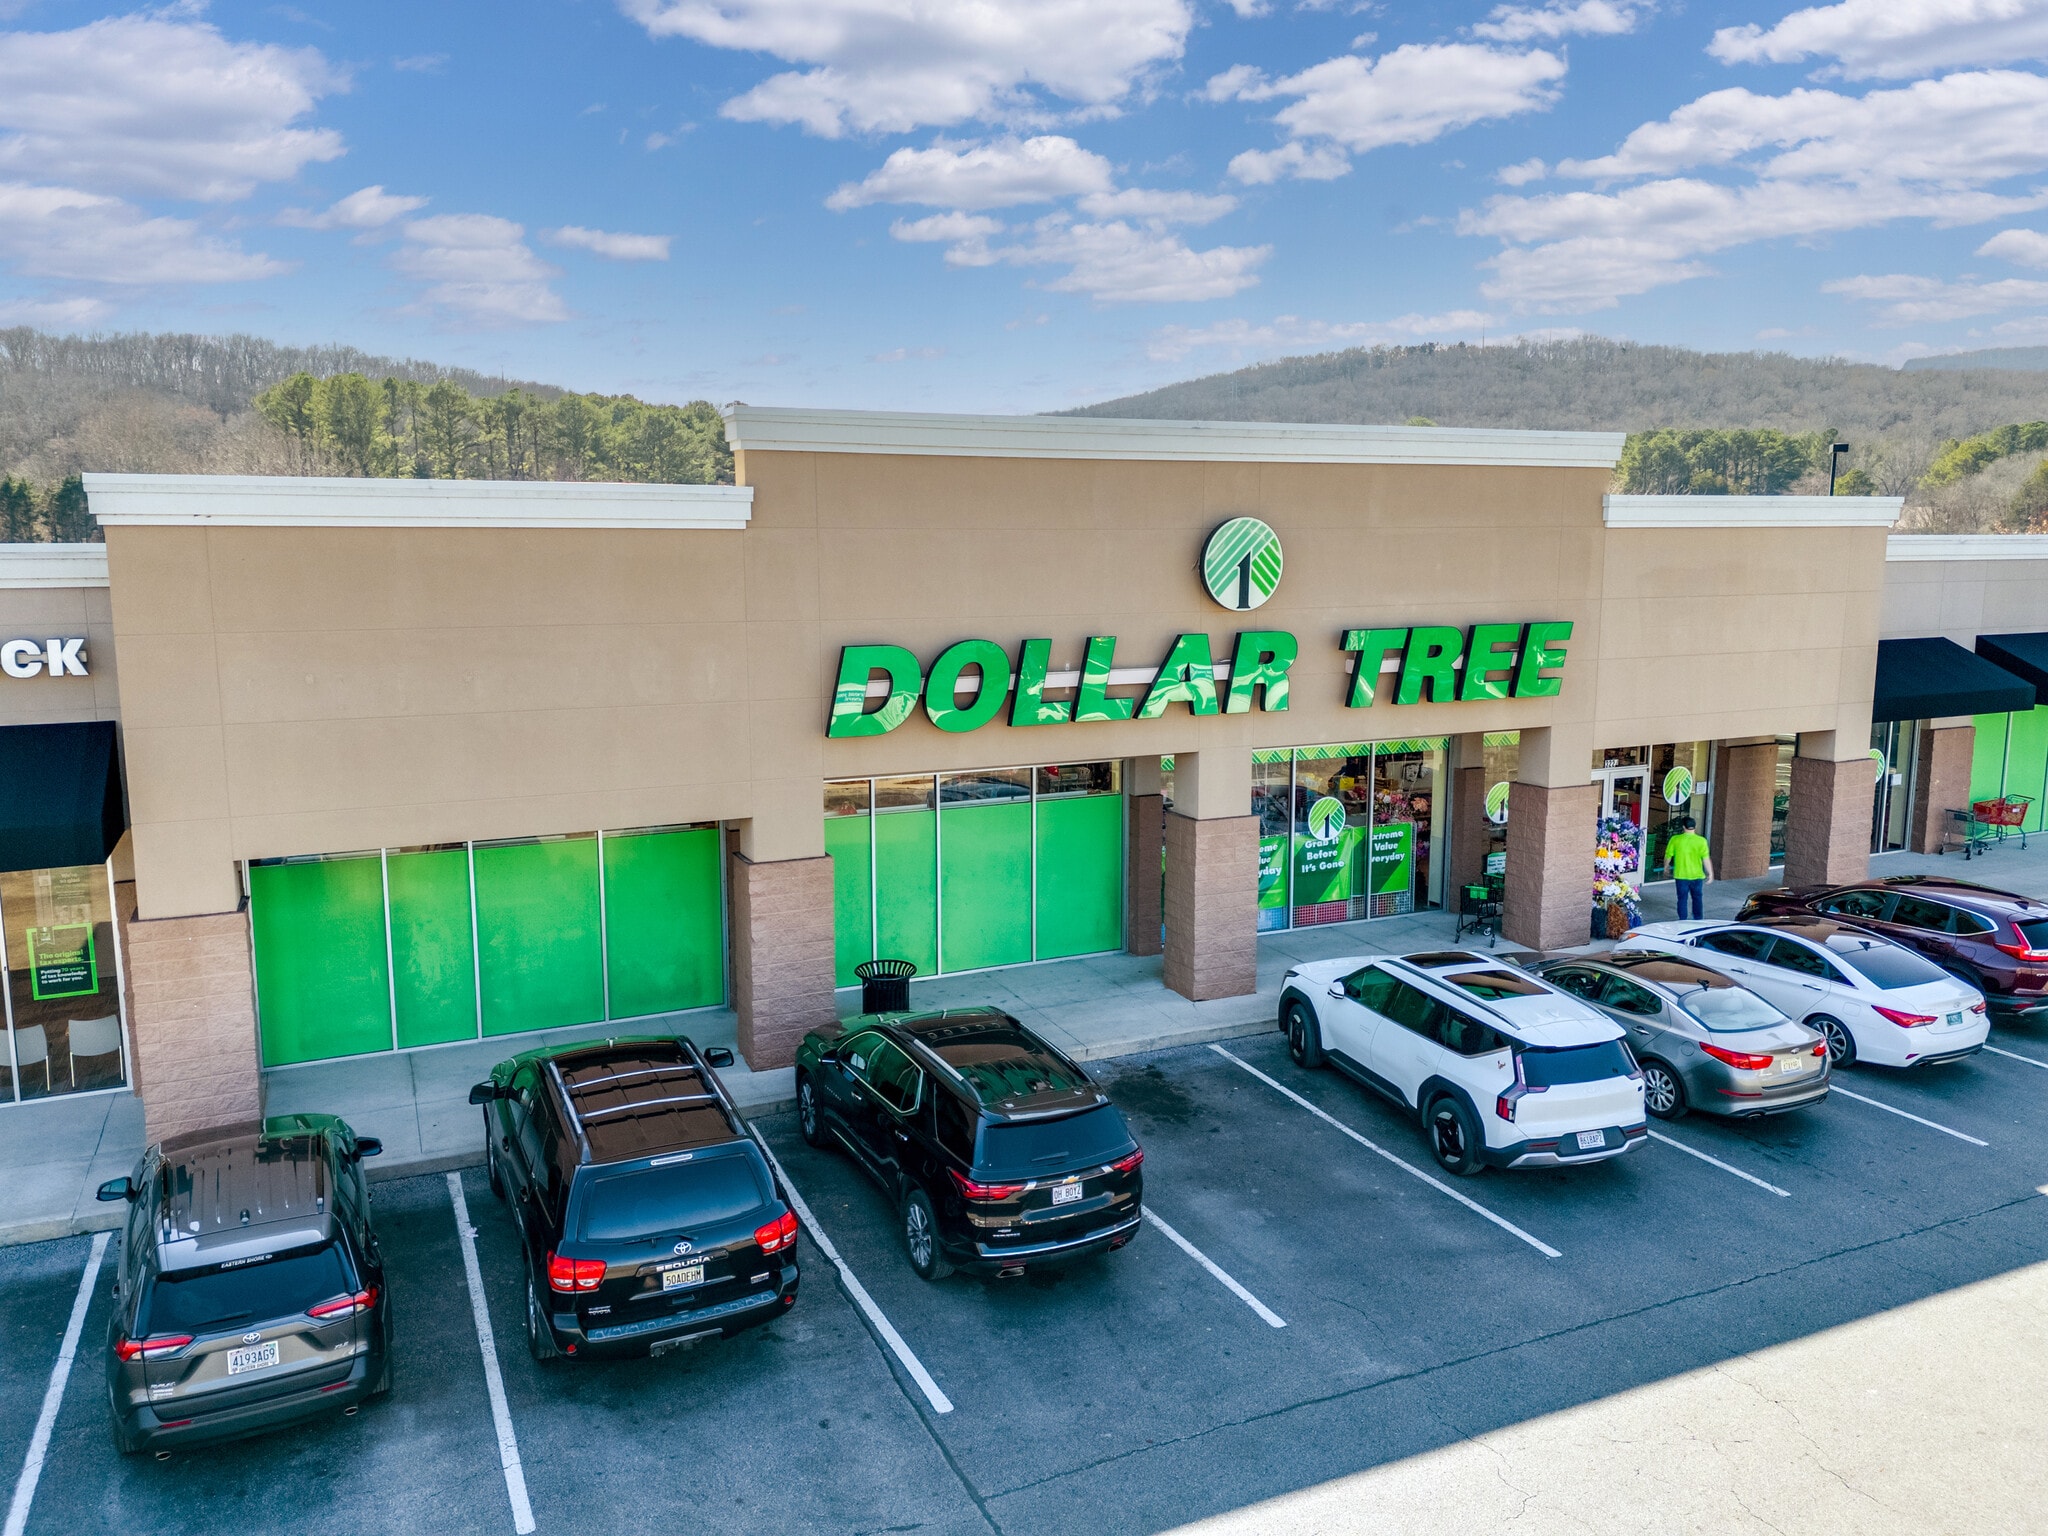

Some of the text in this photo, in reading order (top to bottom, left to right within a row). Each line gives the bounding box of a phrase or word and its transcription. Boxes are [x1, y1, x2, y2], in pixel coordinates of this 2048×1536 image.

[825, 621, 1574, 738] DOLLAR TREE
[1372, 831, 1404, 840] xtreme
[1374, 842, 1399, 851] Value
[1306, 850, 1338, 861] Before
[1371, 852, 1405, 863] veryday
[1301, 860, 1345, 873] It's Gone
[54, 949, 83, 959] original
[656, 1256, 711, 1272] SEQUOIA
[233, 1347, 275, 1367] 4193AG9
